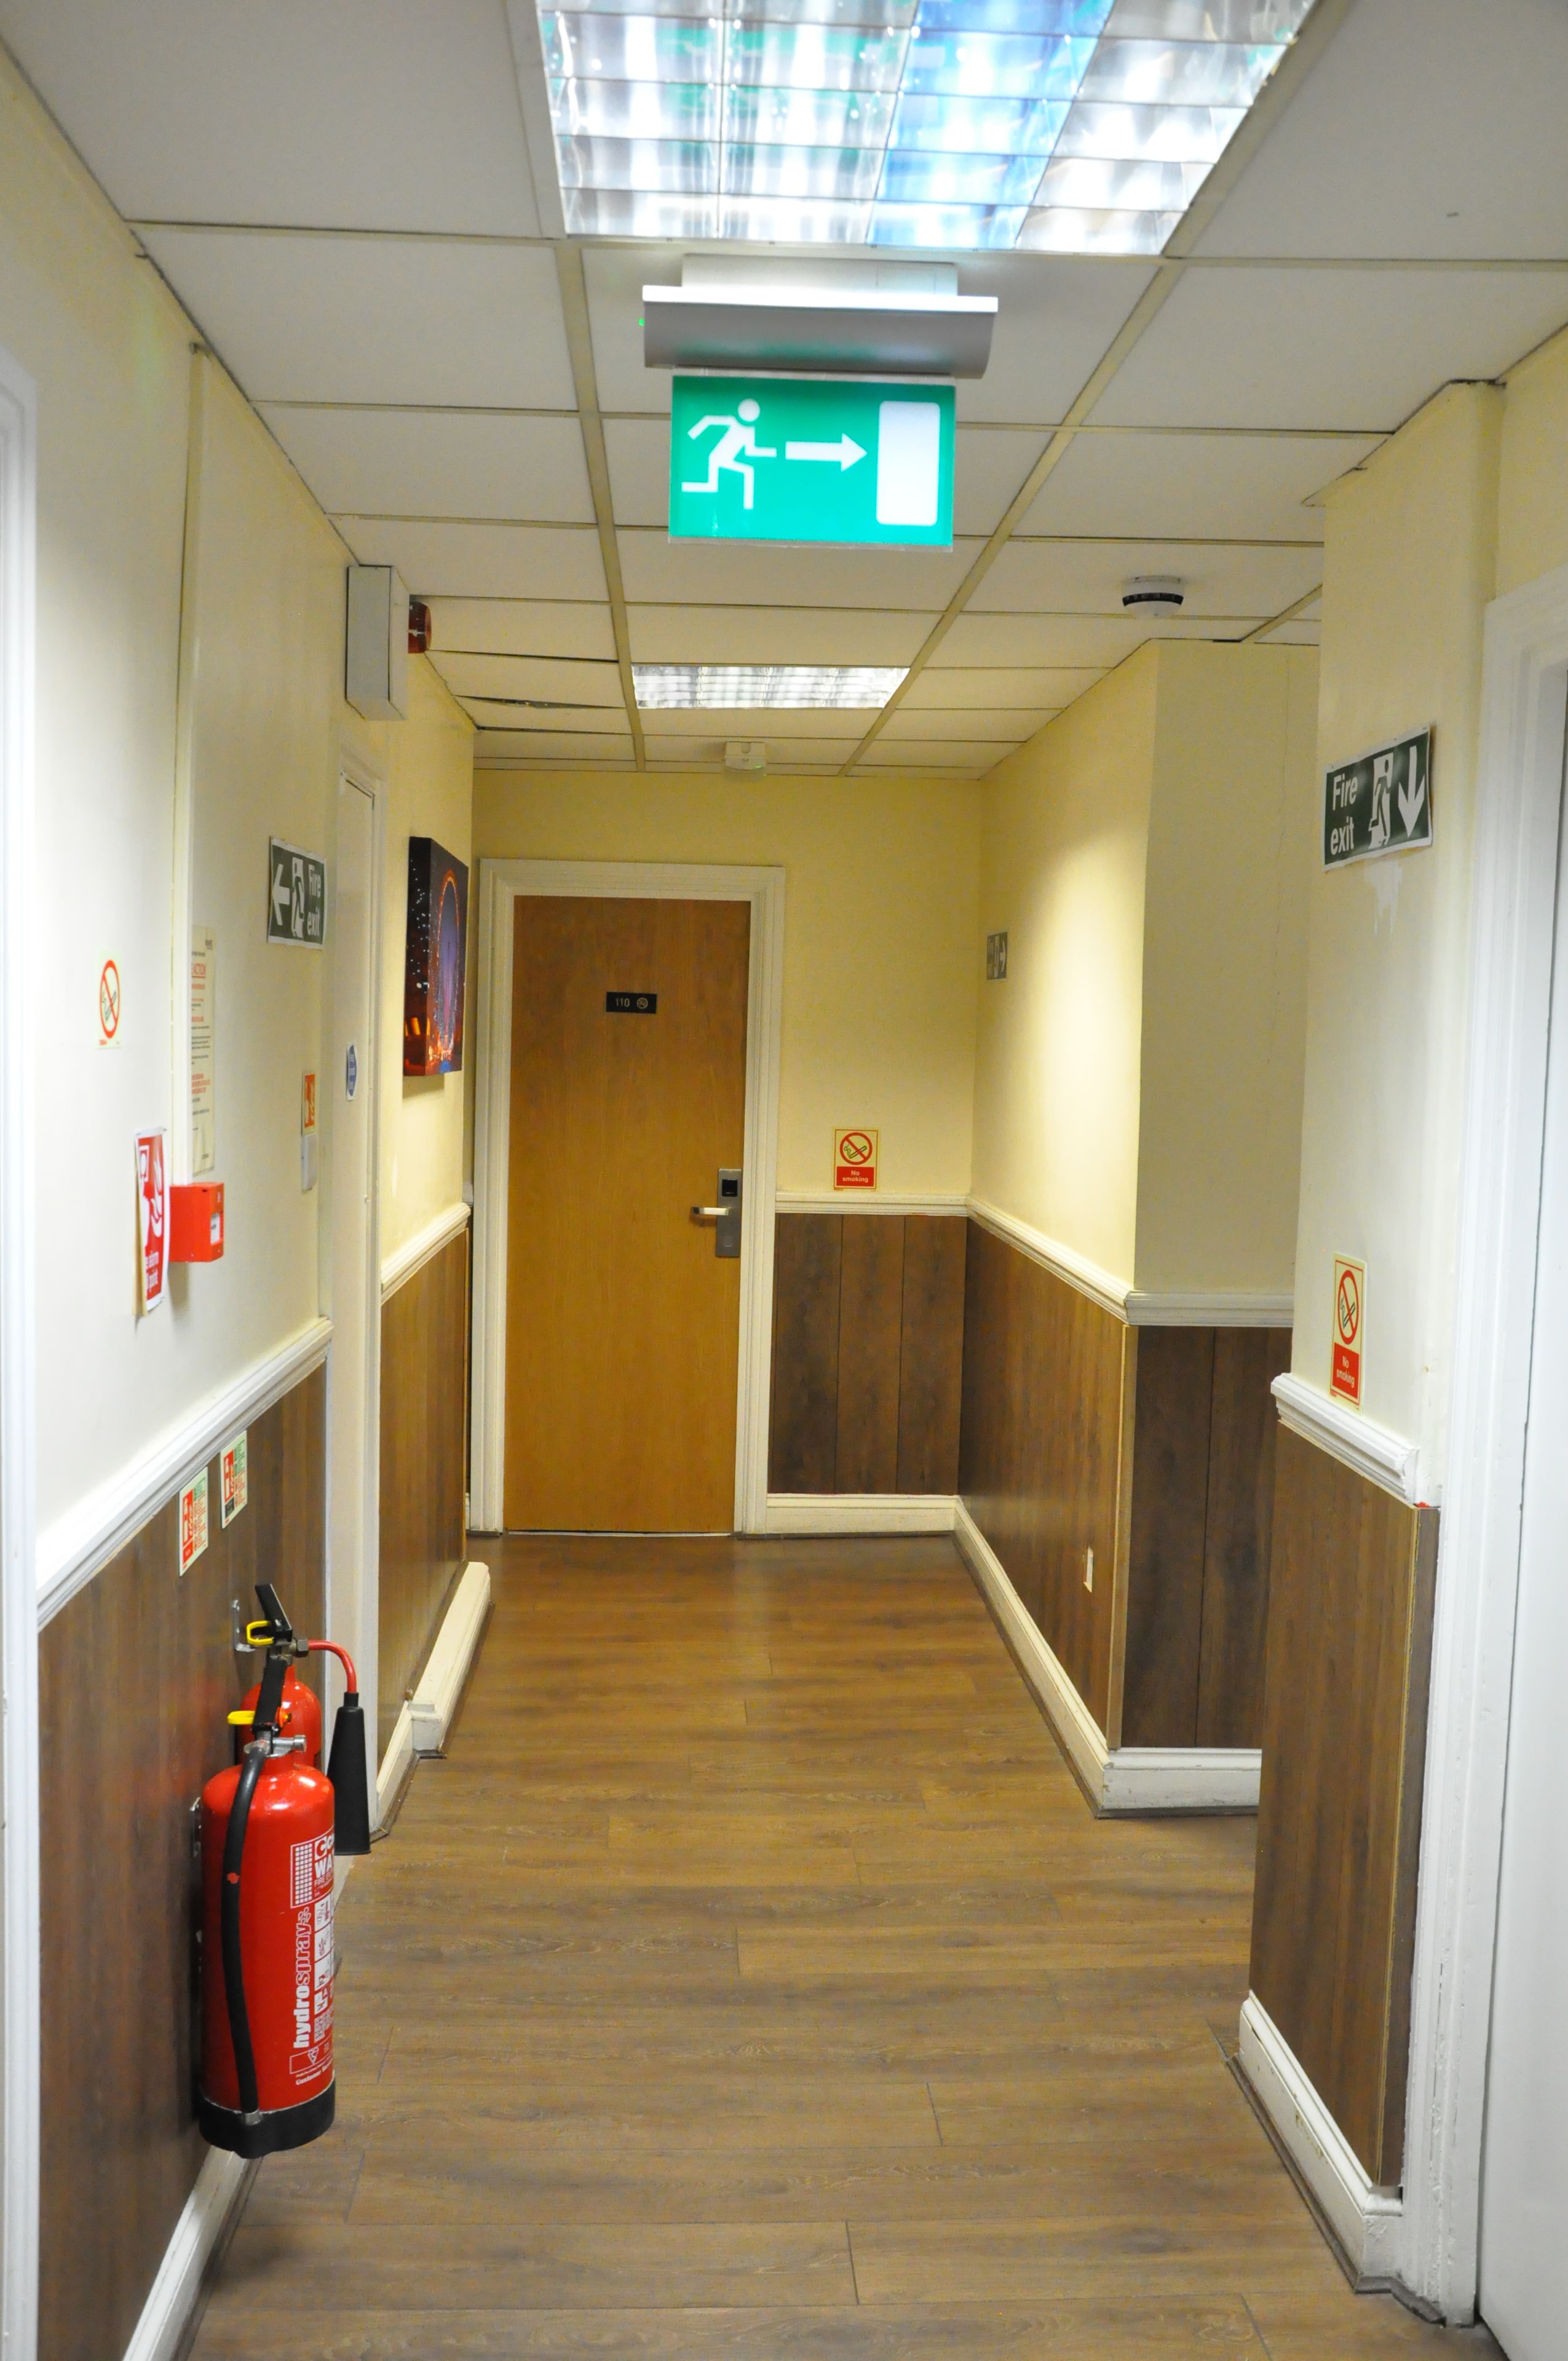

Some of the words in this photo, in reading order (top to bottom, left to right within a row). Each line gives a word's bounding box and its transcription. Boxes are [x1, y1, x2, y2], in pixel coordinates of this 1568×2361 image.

[1332, 773, 1358, 811] Fire
[1330, 817, 1355, 855] exit
[308, 864, 321, 898] Fire
[307, 906, 320, 936] exit
[615, 997, 630, 1008] 110
[1342, 1355, 1350, 1369] No
[1336, 1369, 1355, 1388] smoking
[293, 1922, 312, 2049] hydrospray
